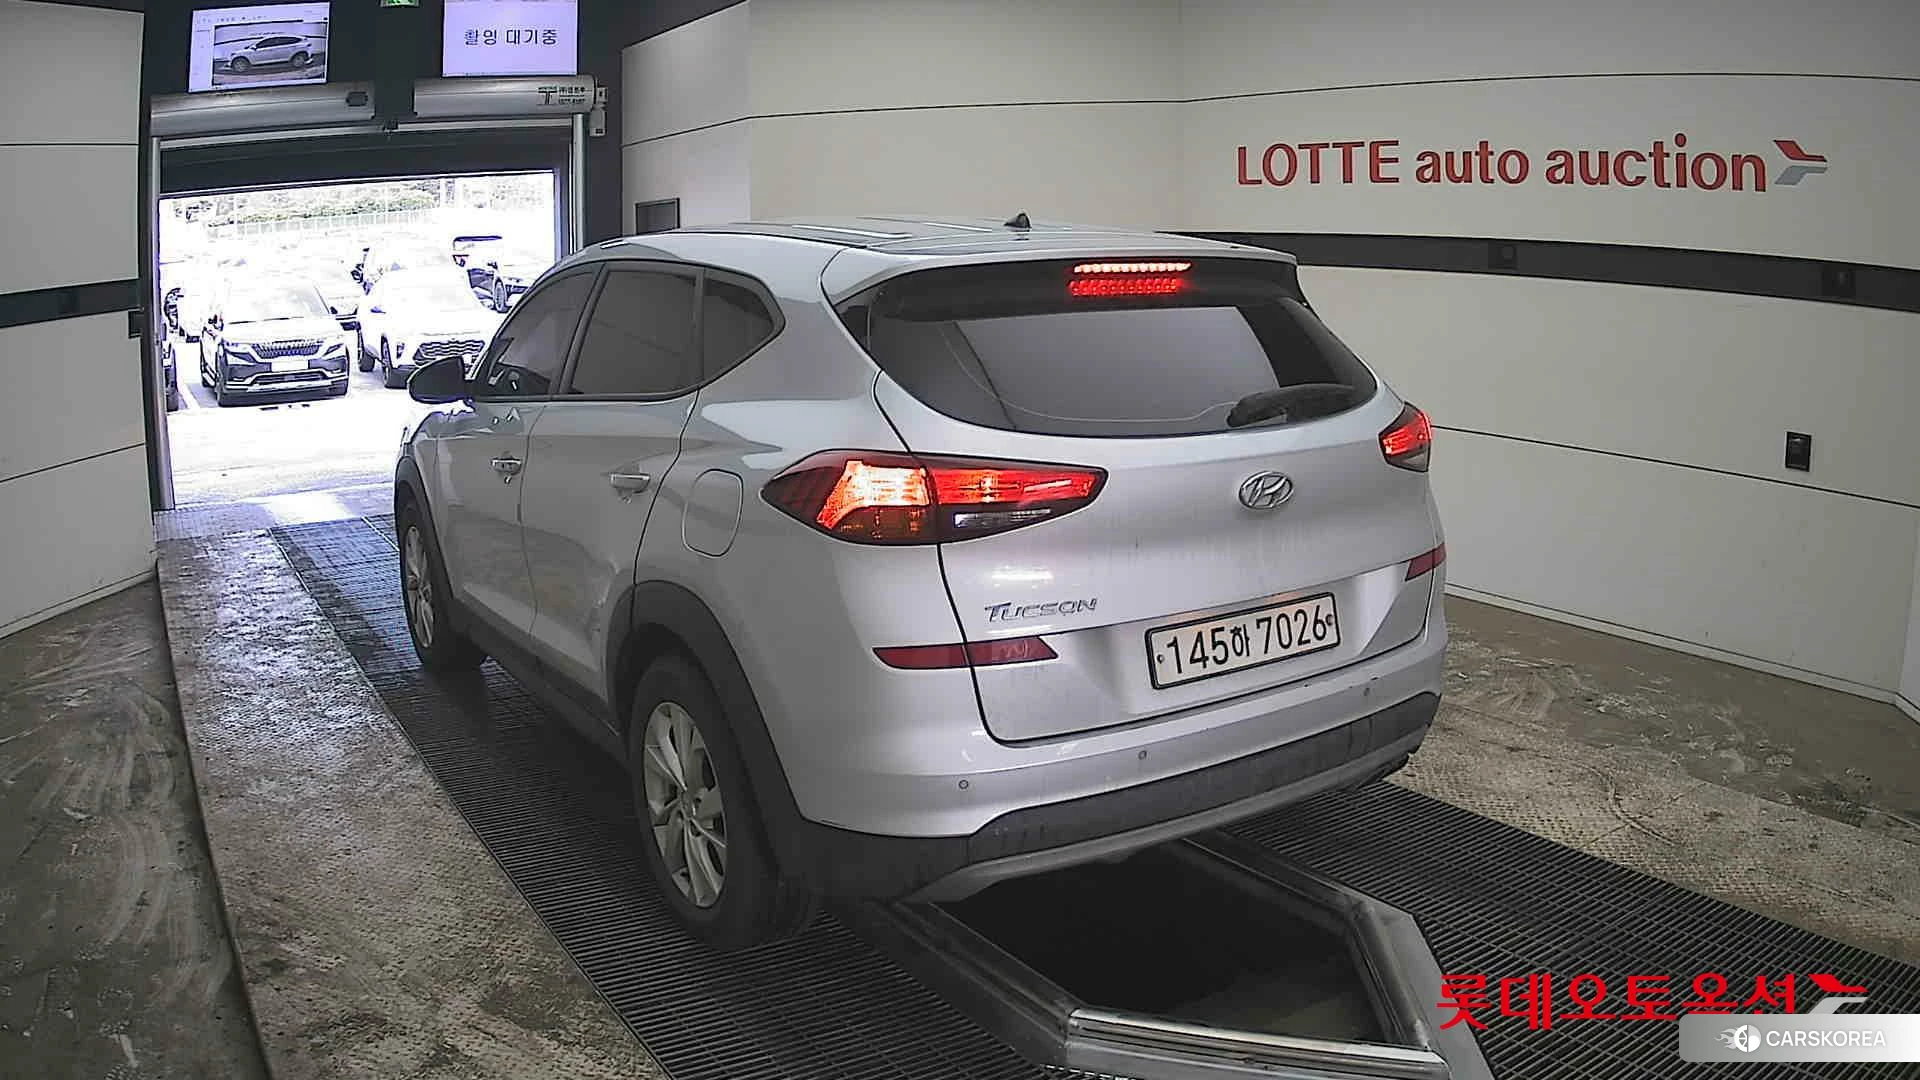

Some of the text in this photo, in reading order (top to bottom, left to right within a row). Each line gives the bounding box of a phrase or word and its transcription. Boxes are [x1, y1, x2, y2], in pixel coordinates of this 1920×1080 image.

[506, 29, 557, 45] 대기중
[1237, 134, 1767, 192] LOTTE auto auction
[984, 598, 1098, 622] TUCSON
[1167, 605, 1327, 674] 145하 7026
